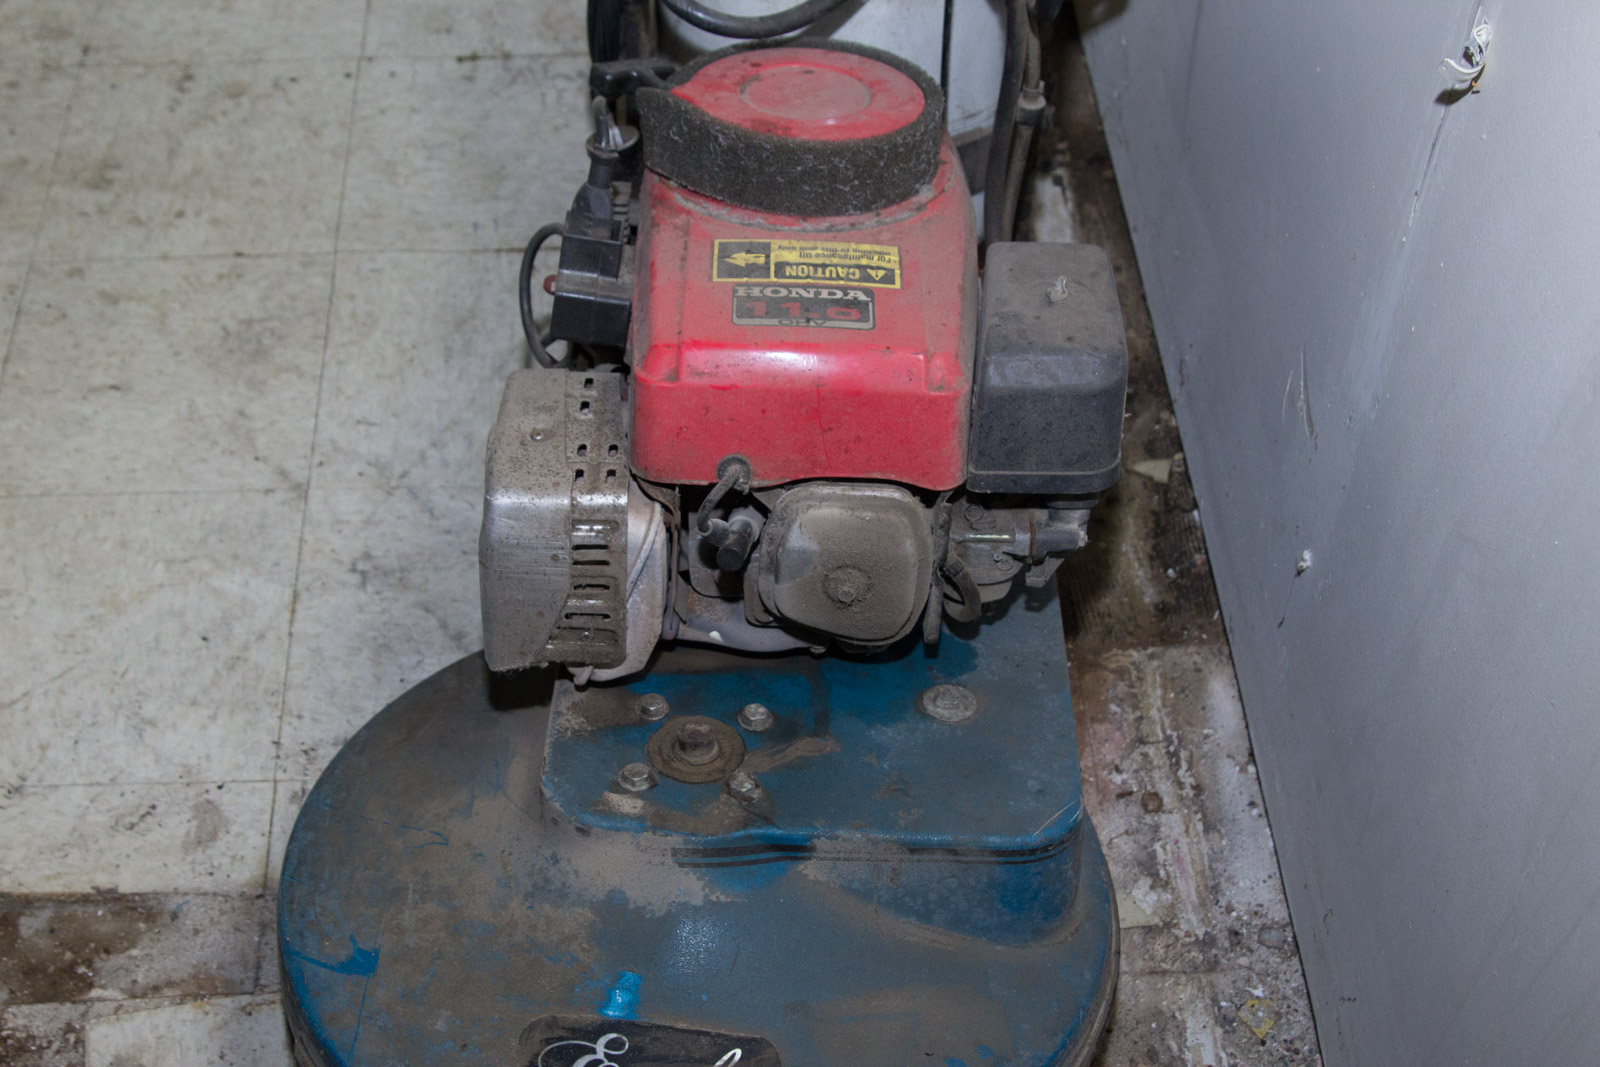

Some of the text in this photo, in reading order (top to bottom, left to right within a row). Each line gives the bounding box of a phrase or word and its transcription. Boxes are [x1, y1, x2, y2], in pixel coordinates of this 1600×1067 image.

[814, 252, 874, 261] maintenance
[785, 264, 860, 280] CAUTION
[734, 286, 872, 301] HONDA
[745, 301, 861, 320] 11.0
